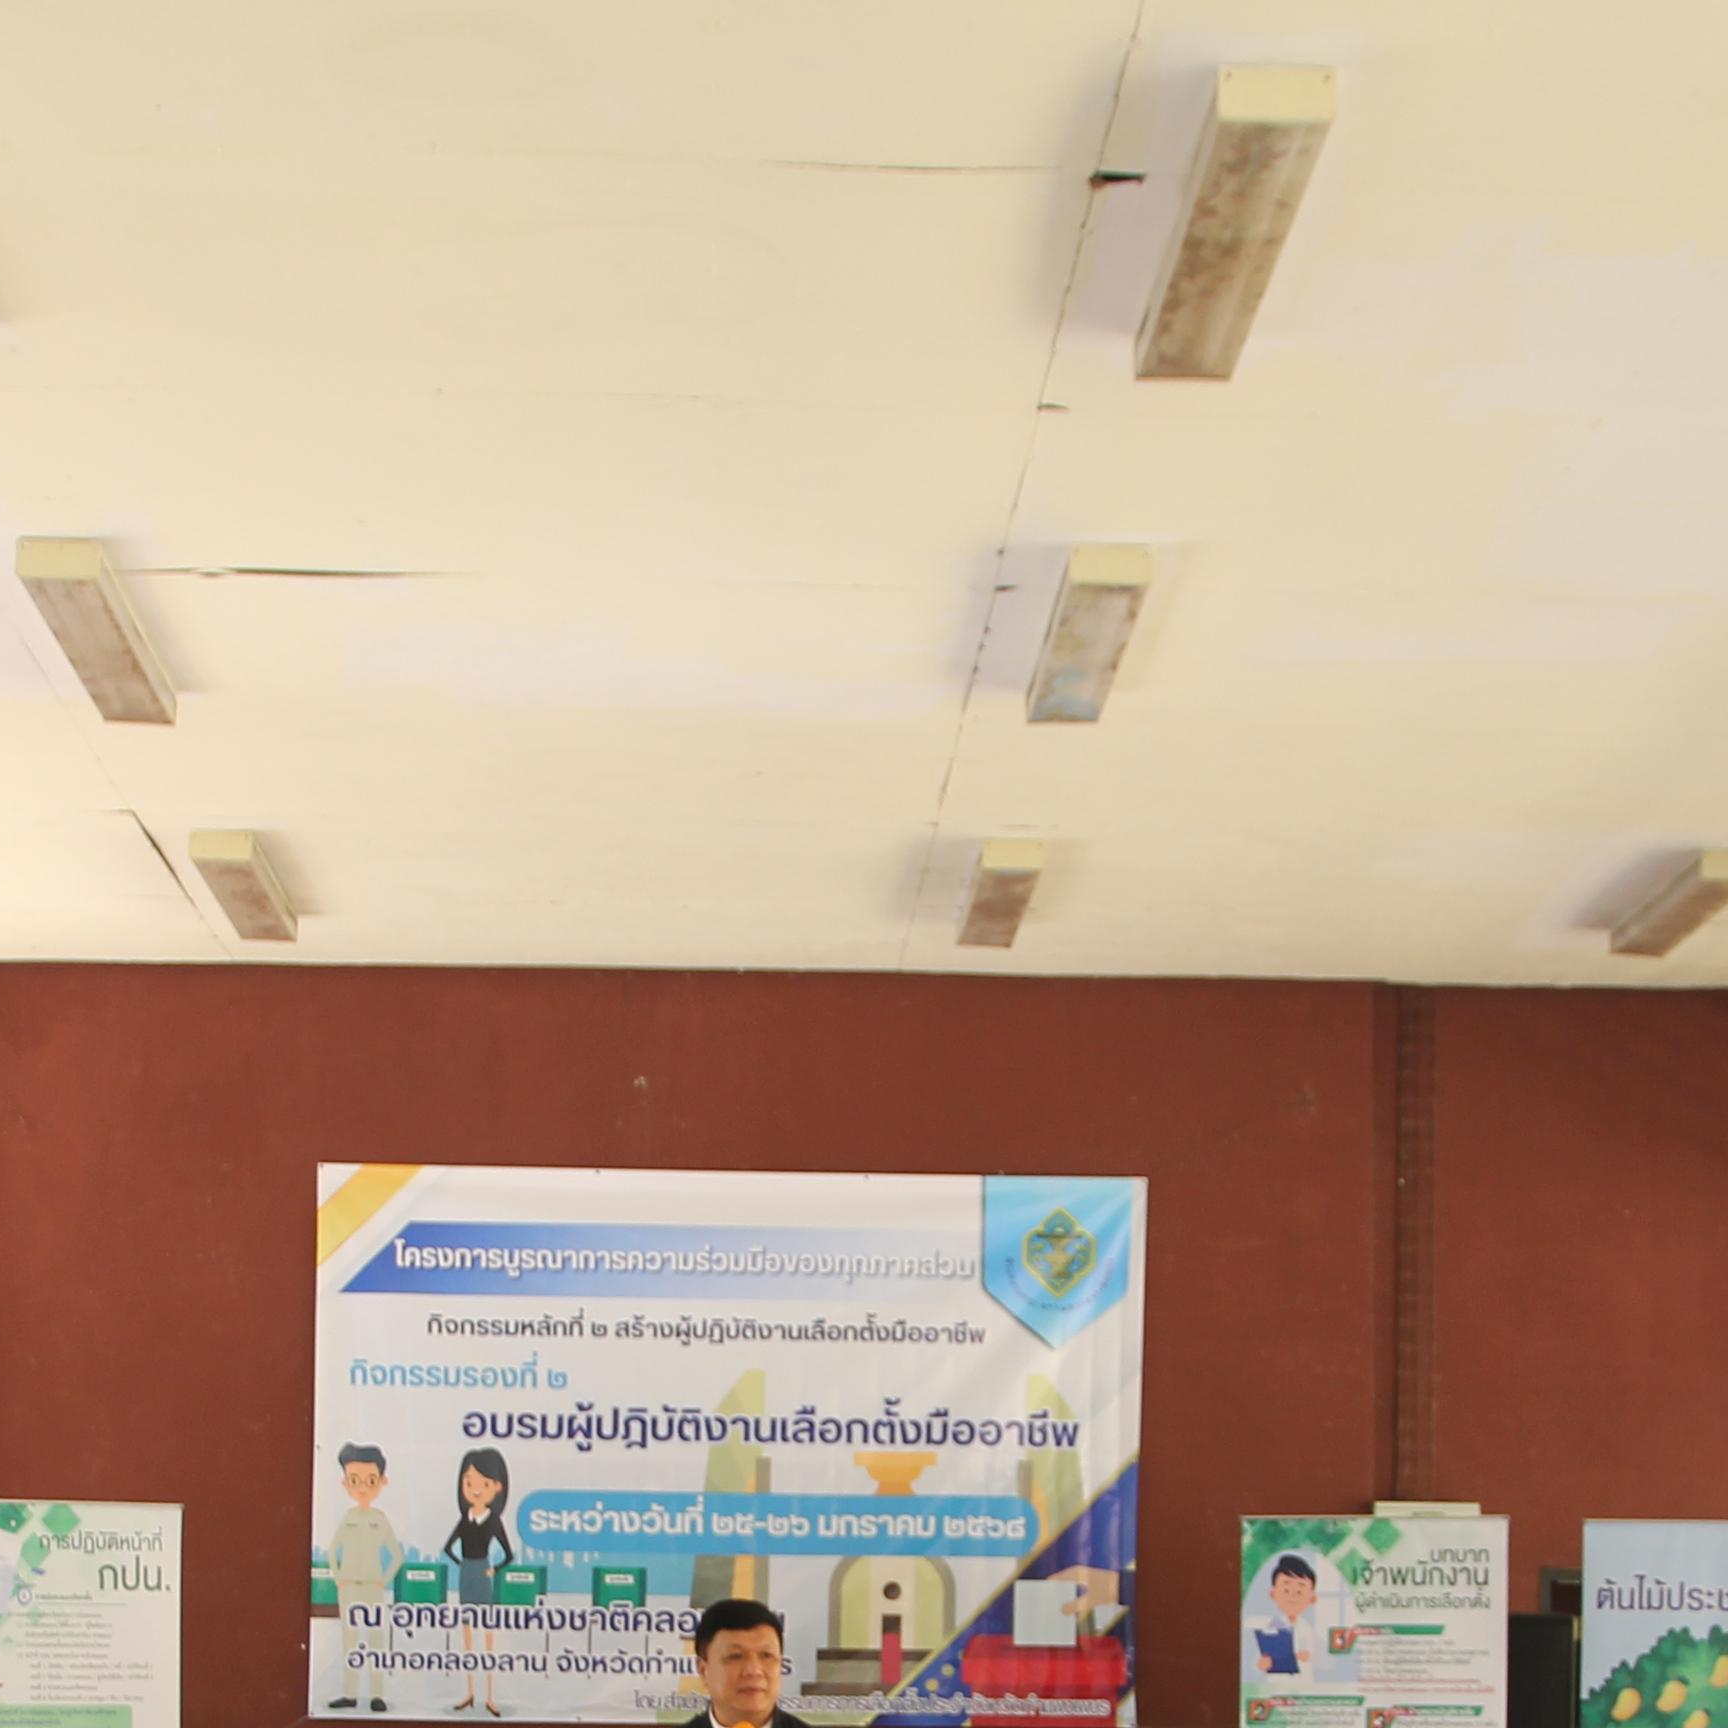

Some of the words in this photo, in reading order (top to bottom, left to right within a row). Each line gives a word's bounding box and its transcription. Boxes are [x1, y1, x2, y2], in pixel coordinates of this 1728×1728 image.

[394, 1239, 974, 1284] โครงการบูรณาการความร่วมมือของทุกภาคส่วน
[427, 1309, 584, 1336] กิจกรรมหลักที่
[591, 1323, 608, 1337] ๒
[349, 1352, 539, 1389] กิจกรรมรองที่
[547, 1370, 568, 1389] ๒
[529, 1494, 704, 1535] ระหว่างวันที่
[712, 1512, 809, 1536] ๒๕-๒๖
[818, 1513, 936, 1538] มกราคม
[944, 1514, 1027, 1539] ๒๕๖๘
[98, 1556, 172, 1592] กปน.
[1351, 1559, 1489, 1587] เจ้าพนักงาน
[348, 1603, 381, 1630] ณ
[392, 1594, 784, 1638] อุทยานแห่งชาติคลอ
[347, 1644, 548, 1674] อำเภอคลองลาน
